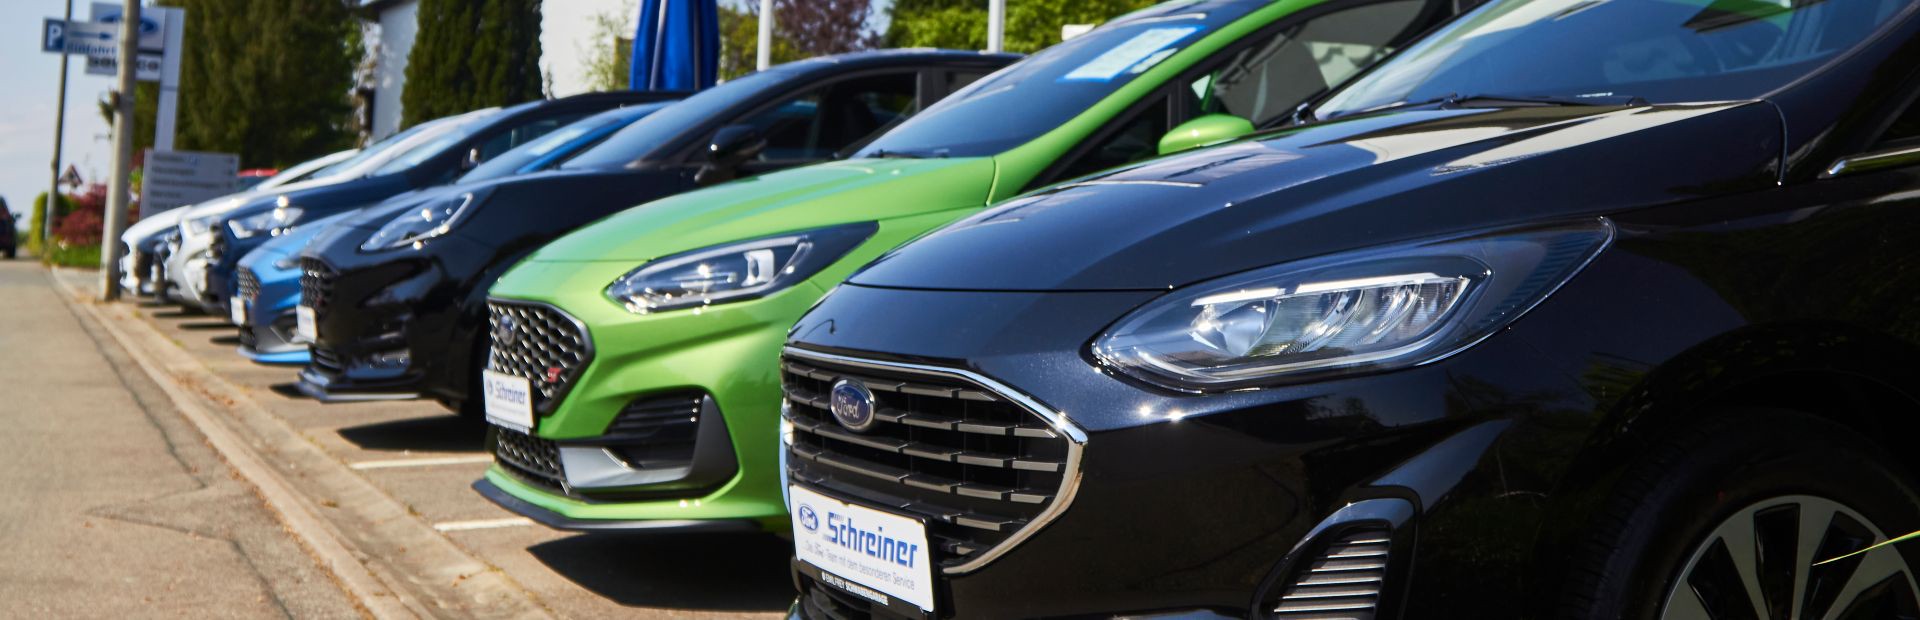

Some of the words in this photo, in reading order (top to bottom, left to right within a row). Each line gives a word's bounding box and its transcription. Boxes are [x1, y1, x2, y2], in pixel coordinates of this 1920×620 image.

[48, 24, 62, 48] P
[495, 381, 526, 405] Schreiner
[836, 393, 861, 419] Ford
[823, 511, 918, 569] Schreiner
[892, 571, 915, 591] Service
